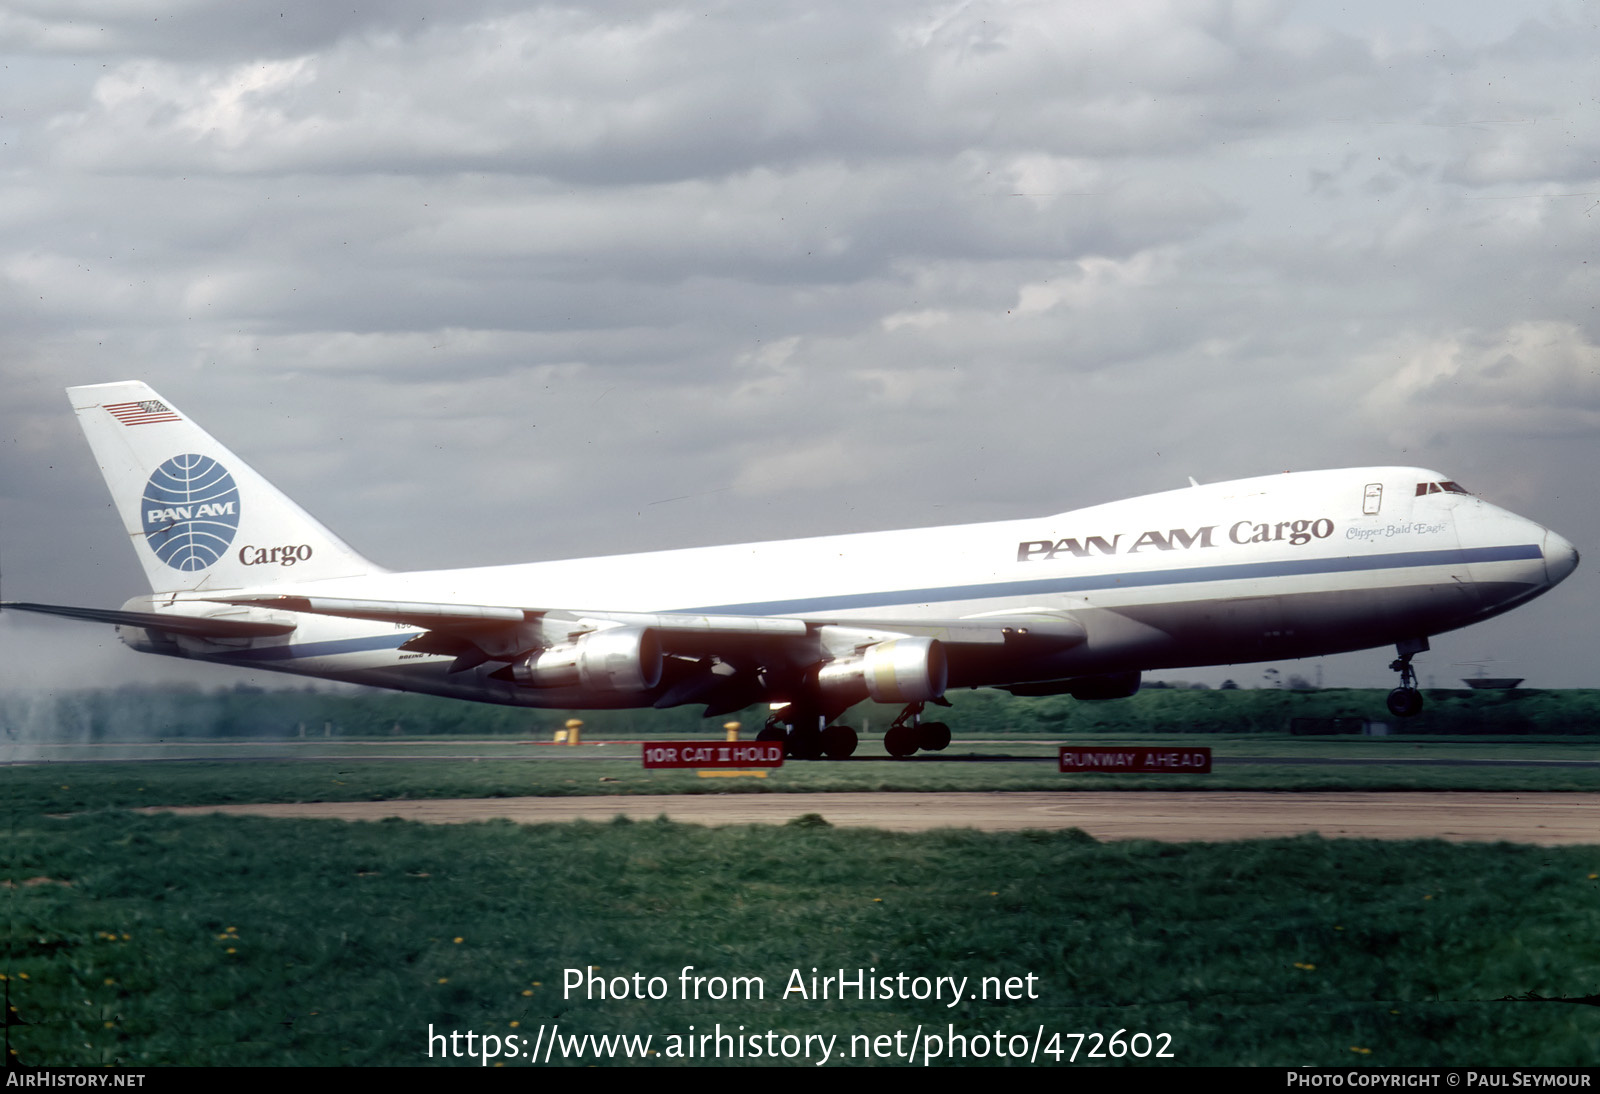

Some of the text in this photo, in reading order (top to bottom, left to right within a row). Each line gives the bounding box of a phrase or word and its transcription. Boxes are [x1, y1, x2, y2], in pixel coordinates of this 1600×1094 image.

[147, 502, 236, 523] PAN AM
[1017, 518, 1335, 562] PAN AM Cargo
[1345, 521, 1447, 540] Clipper Bald Eagle
[239, 544, 312, 566] Cargo
[645, 748, 678, 763] 10R
[681, 747, 714, 762] CAT
[733, 747, 781, 762] HOLD
[1063, 752, 1206, 767] RUNWAY AHEAD
